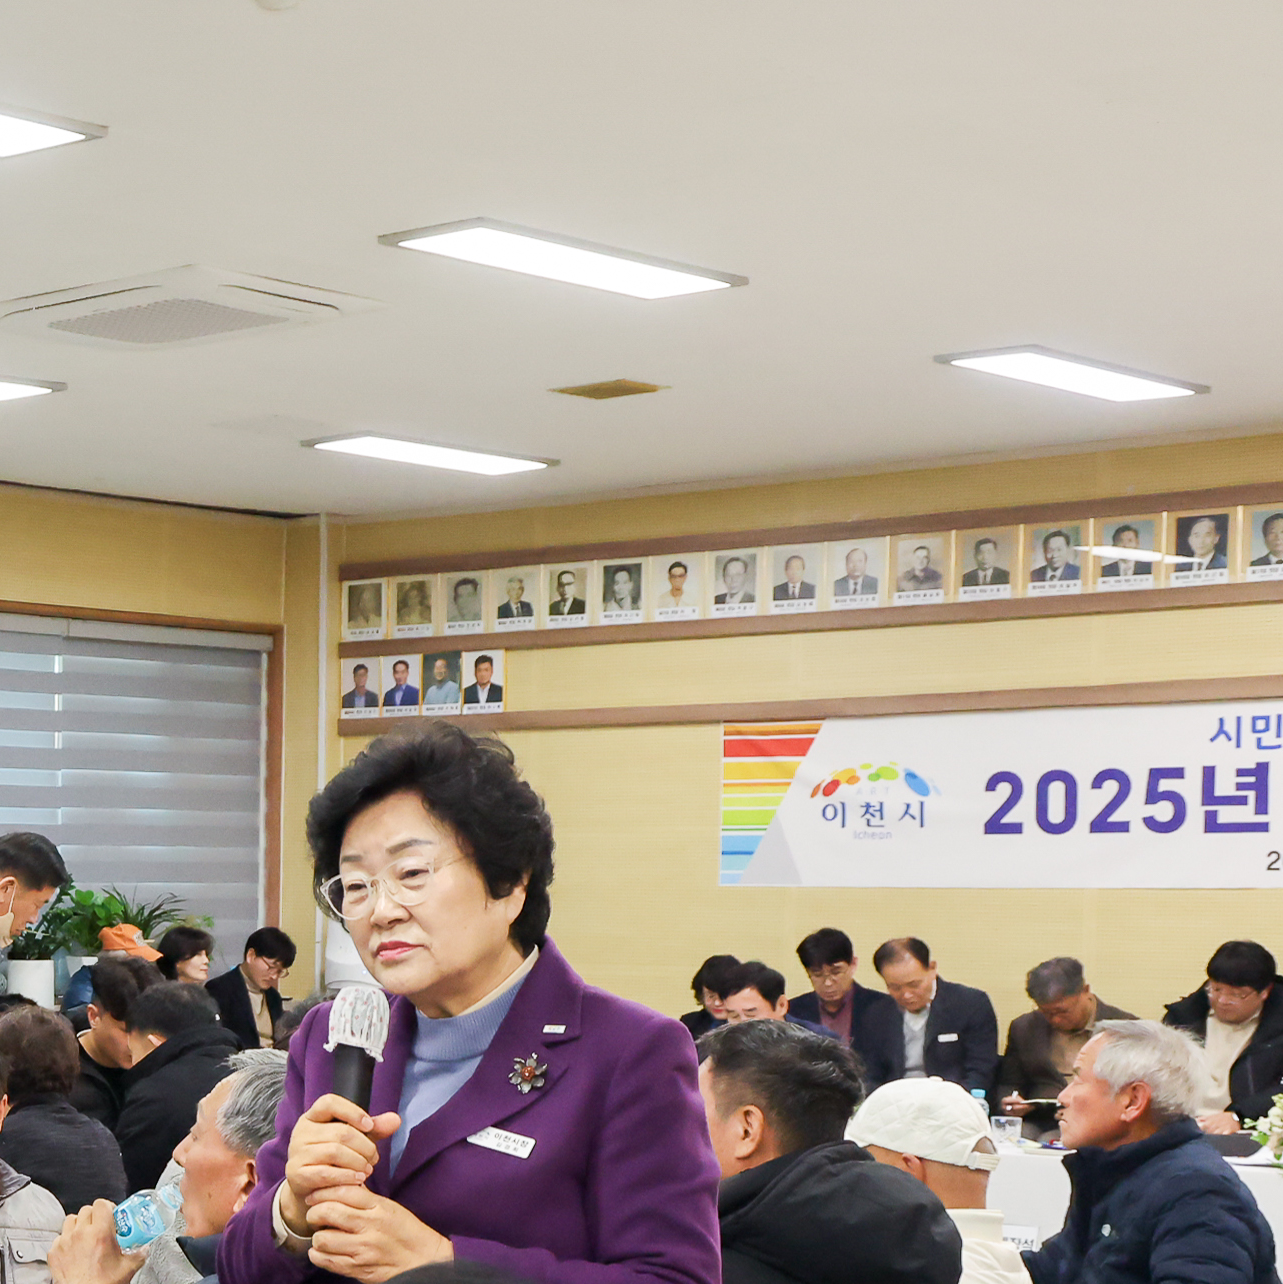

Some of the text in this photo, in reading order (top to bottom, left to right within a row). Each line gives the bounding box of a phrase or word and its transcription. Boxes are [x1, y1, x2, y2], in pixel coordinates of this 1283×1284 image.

[984, 761, 1270, 835] 2025년
[822, 801, 925, 828] 이천시
[853, 830, 892, 840] Icheon
